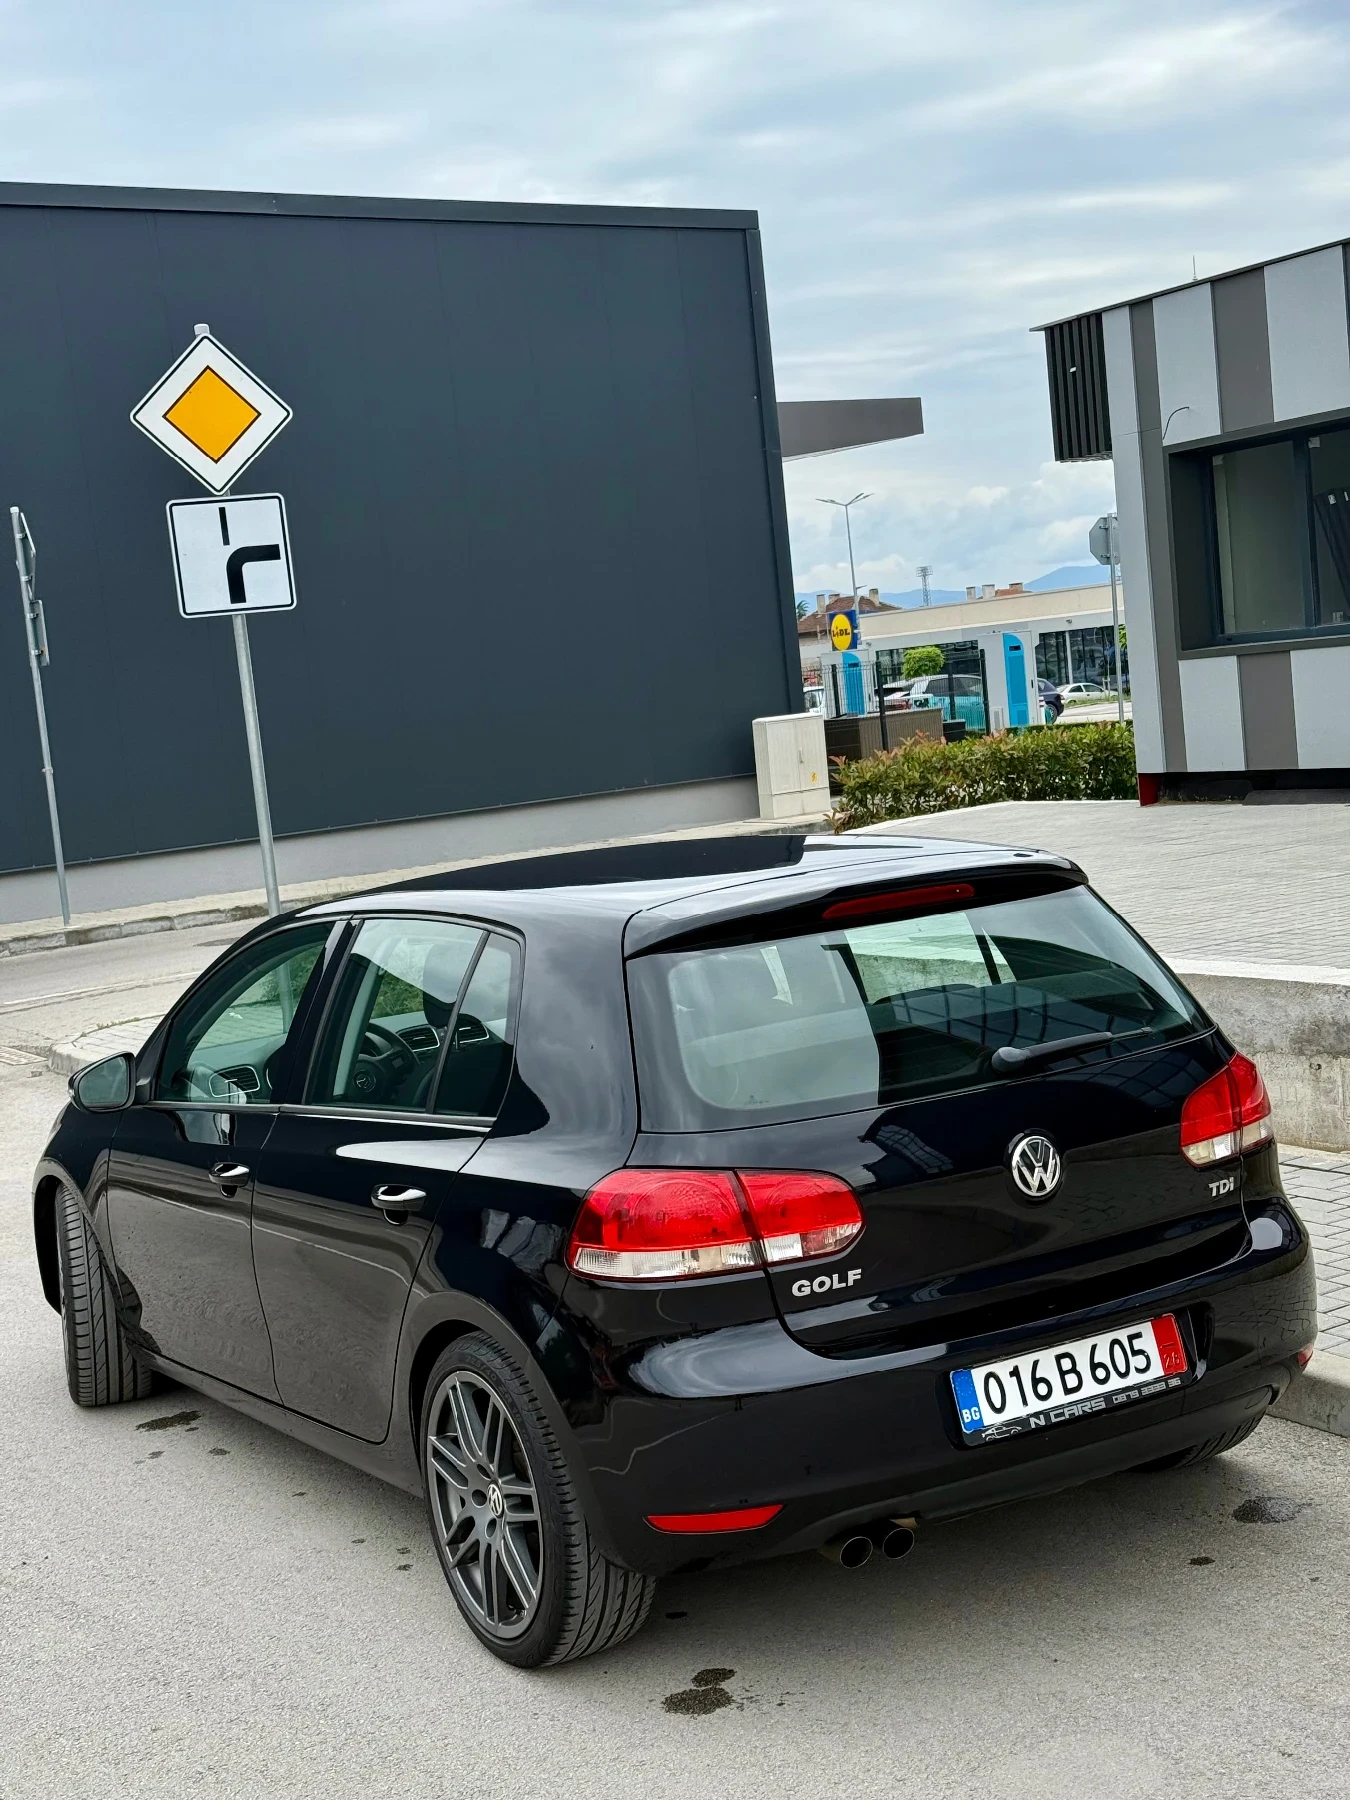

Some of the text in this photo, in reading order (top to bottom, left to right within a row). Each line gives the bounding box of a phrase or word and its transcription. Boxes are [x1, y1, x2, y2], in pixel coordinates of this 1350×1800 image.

[791, 1268, 862, 1297] GOLF
[961, 1406, 981, 1423] BG
[1029, 1414, 1046, 1429] N
[1050, 1398, 1107, 1423] CARS
